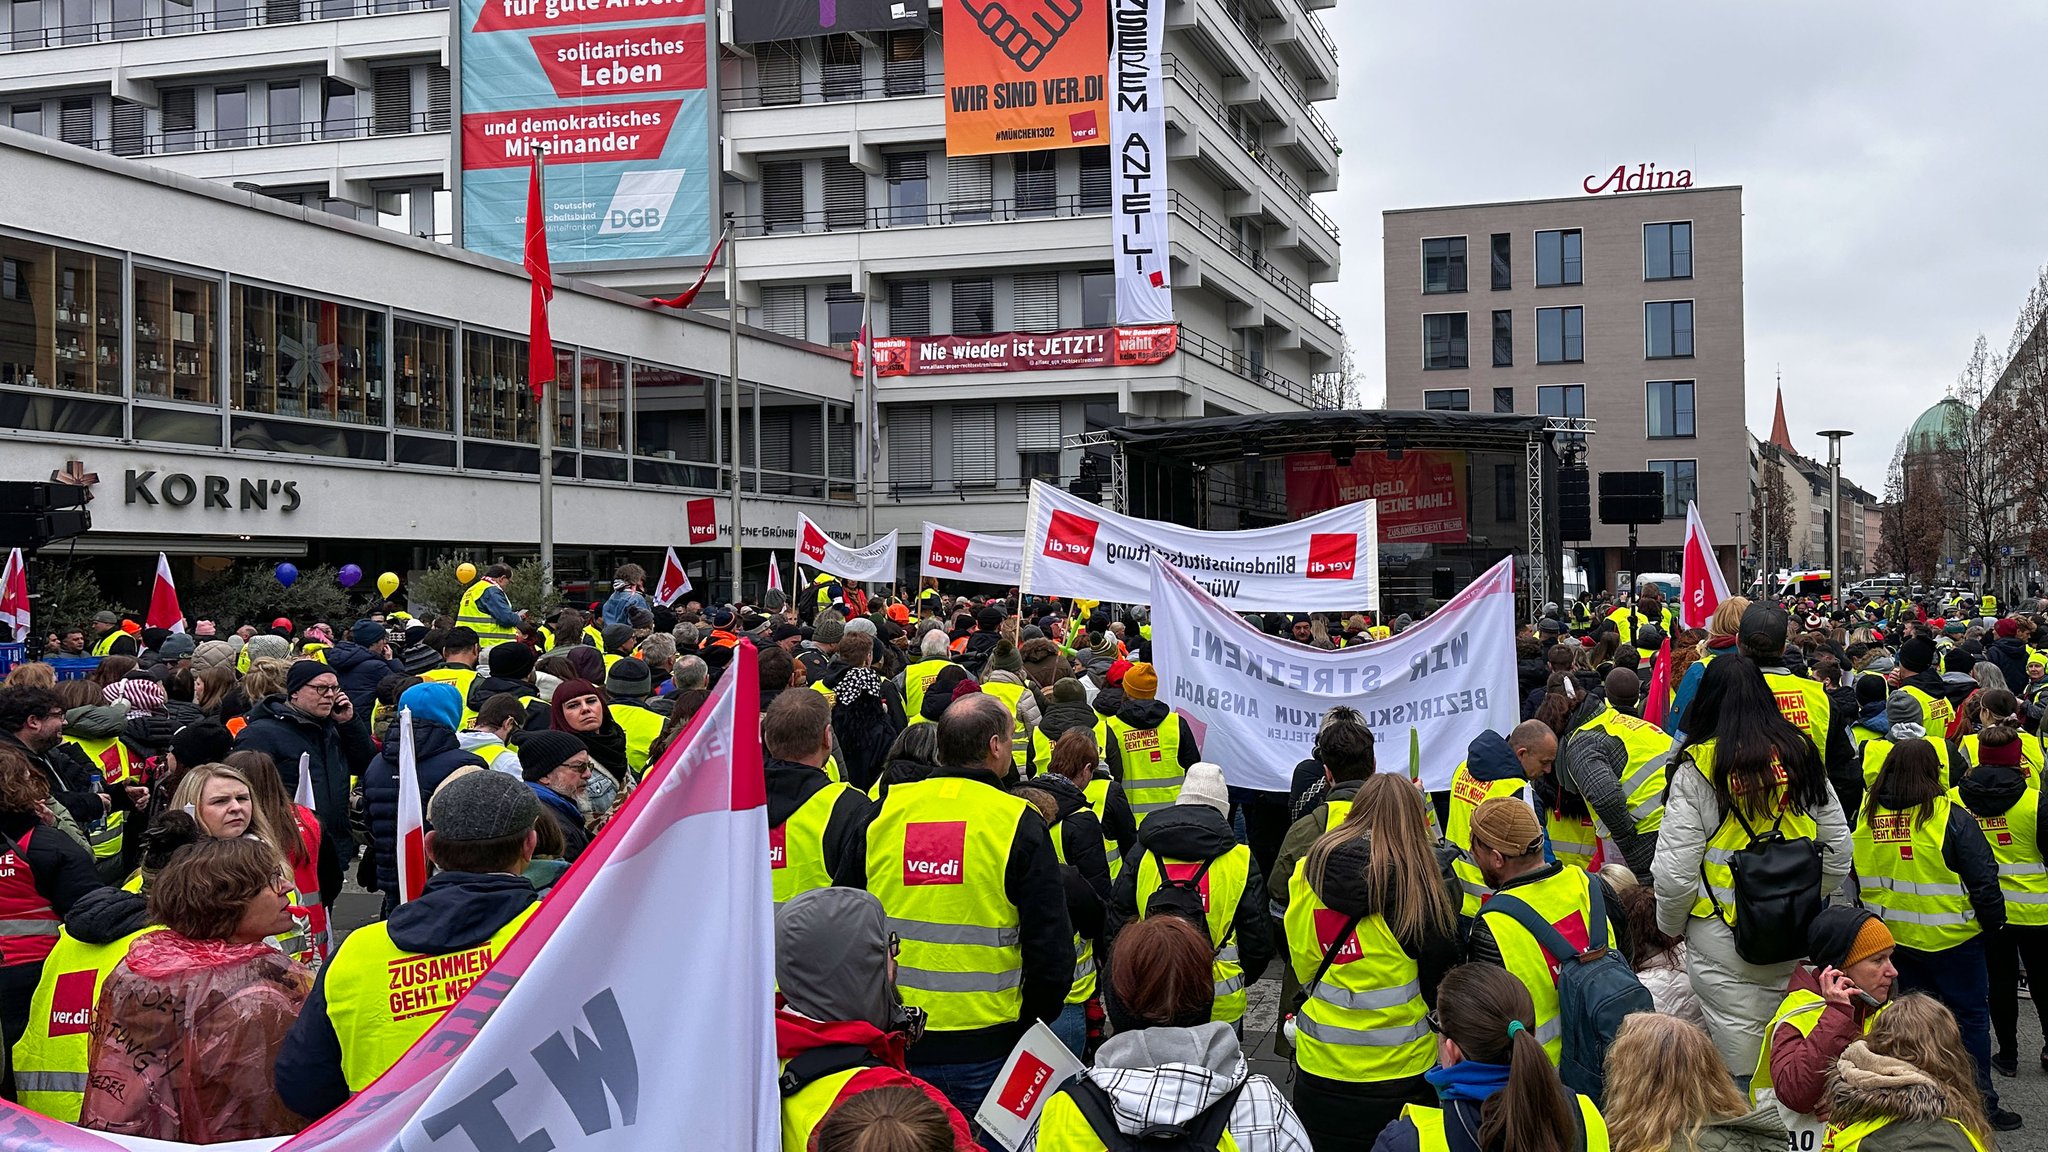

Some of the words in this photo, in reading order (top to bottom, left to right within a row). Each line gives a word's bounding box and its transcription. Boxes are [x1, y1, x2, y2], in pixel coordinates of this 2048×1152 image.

[557, 38, 685, 63] solidarisches
[580, 61, 662, 87] Leben
[951, 84, 988, 113] WIR
[994, 80, 1037, 110] SIND
[1043, 75, 1103, 106] VER.DI
[484, 119, 517, 136] und
[521, 111, 661, 134] demokratisches
[996, 127, 1055, 141] #MÜNCHEN1302
[505, 132, 640, 158] Miteinander
[1583, 162, 1694, 194] Adina
[553, 202, 597, 210] Deutscher
[1122, 132, 1153, 275] ANTEIL!
[611, 207, 661, 229] DGB
[873, 340, 906, 348] emokratie
[920, 343, 946, 360] Nie
[952, 341, 1008, 358] wieder
[1012, 338, 1035, 357] ist
[1119, 336, 1153, 351] wählt
[125, 469, 301, 512] KORN'S
[1340, 483, 1371, 501] MEHR
[1373, 479, 1409, 498] GELD,
[1377, 496, 1414, 515] EINE
[1415, 491, 1453, 509] WAHL!
[1124, 741, 1142, 751] GEHT
[1142, 738, 1159, 748] MEHR
[1872, 829, 1889, 840] GEHT
[1891, 828, 1911, 839] MEHR
[1986, 818, 2007, 828] MEHR
[907, 858, 959, 877] ver.di
[388, 948, 493, 990] ZUSAMMEN
[389, 985, 439, 1014] GEHT
[53, 1008, 89, 1025] ver.di
